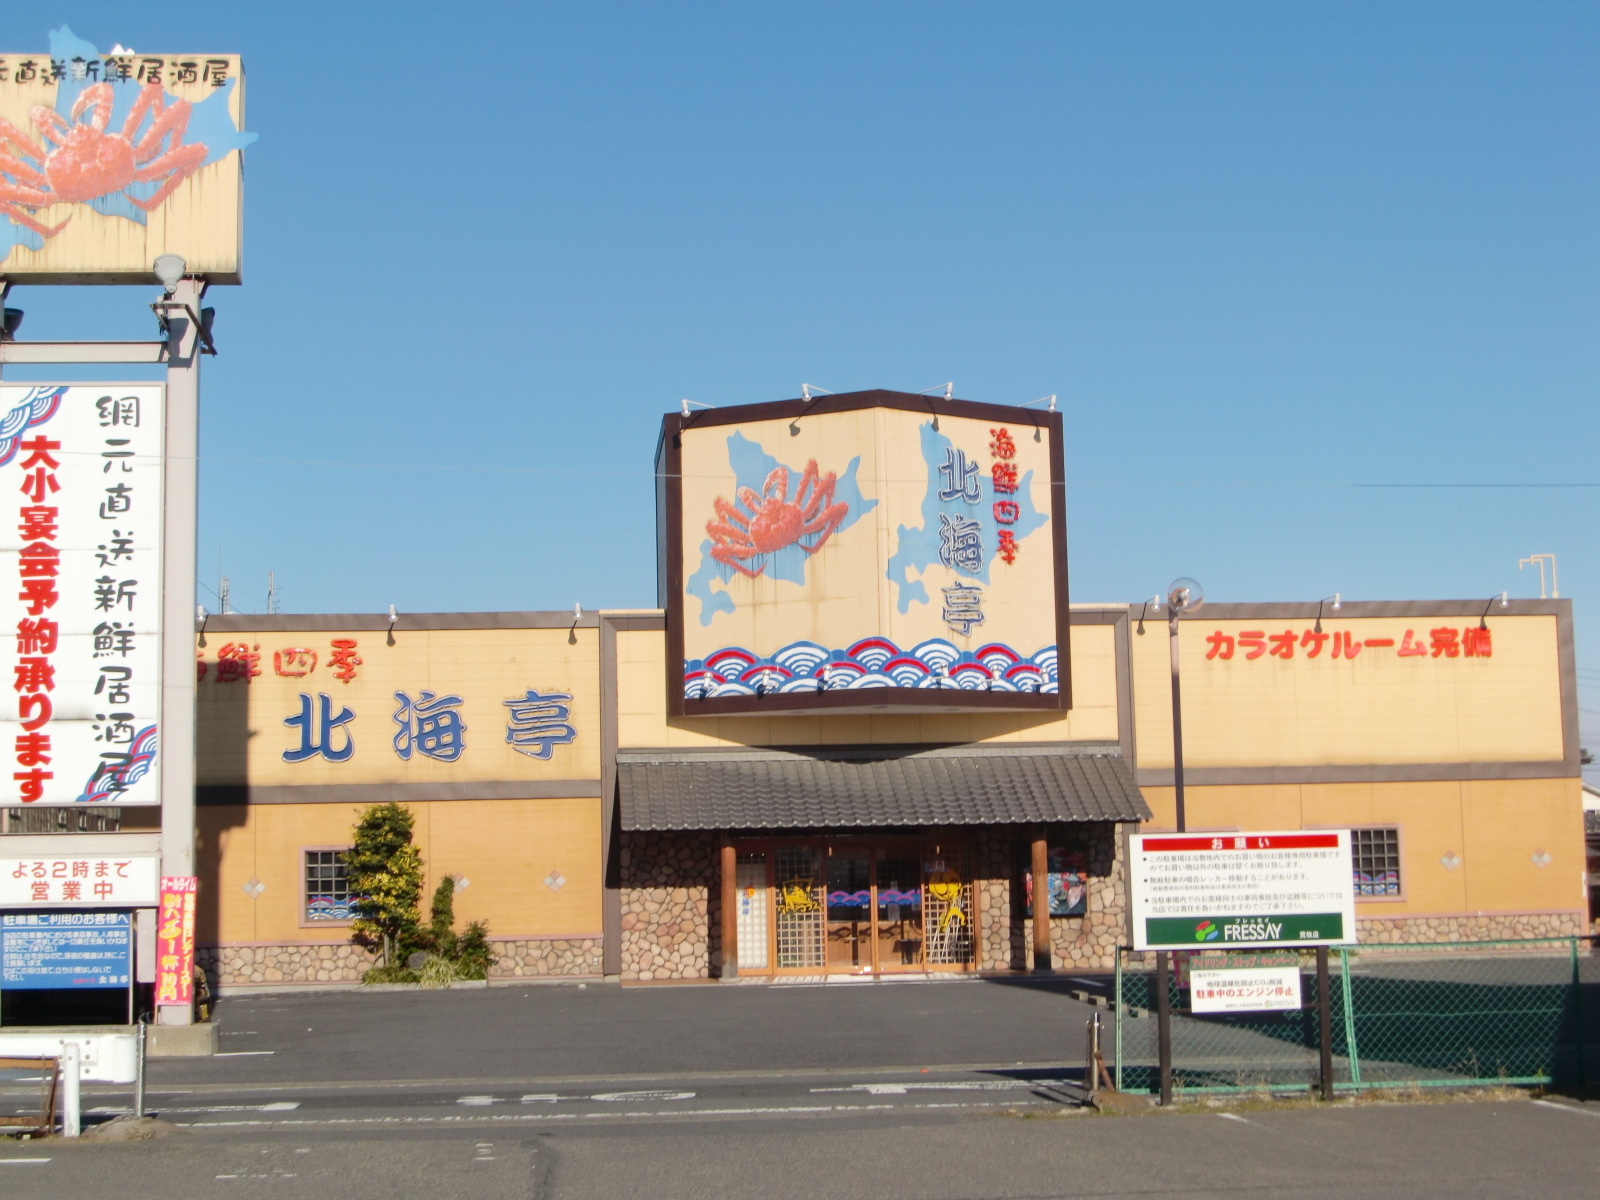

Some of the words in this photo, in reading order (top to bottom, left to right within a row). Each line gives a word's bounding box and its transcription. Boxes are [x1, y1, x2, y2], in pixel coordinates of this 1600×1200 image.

[989, 428, 1021, 565] 海鮮四季
[938, 447, 984, 637] 北海亭
[93, 396, 140, 793] 網元直送新鮮居酒屋
[13, 435, 61, 802] 大小宴会予約承ります
[1205, 627, 1492, 660] カラオケルーム完備
[196, 639, 362, 684] 鮮四季
[282, 690, 578, 762] 北海亭
[1211, 836, 1270, 850] お願い
[12, 861, 132, 879] よる2時まで
[31, 881, 114, 901] 営業中
[161, 877, 196, 891] オールタイム
[3, 913, 129, 926] 駐車場ご利用のお客様へ
[1235, 917, 1270, 925] フレッセイ
[1224, 923, 1282, 941] FRESSAY
[1196, 987, 1294, 999] 駐車中のエンジン停止
